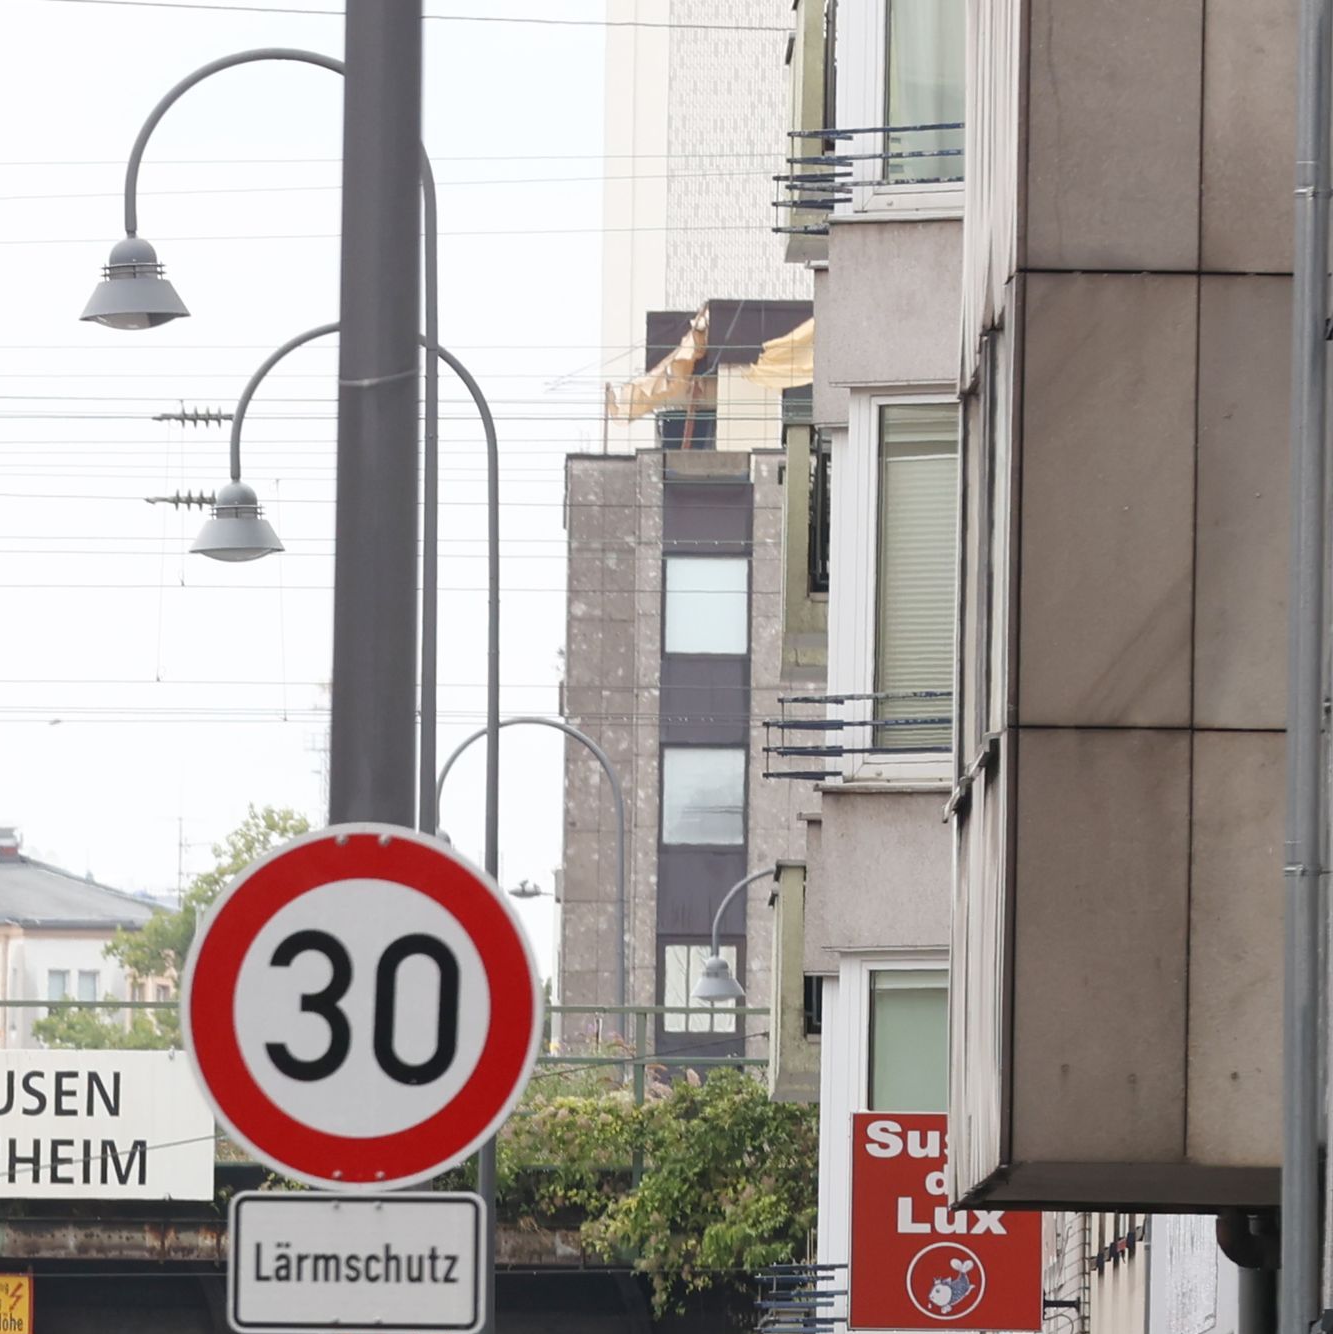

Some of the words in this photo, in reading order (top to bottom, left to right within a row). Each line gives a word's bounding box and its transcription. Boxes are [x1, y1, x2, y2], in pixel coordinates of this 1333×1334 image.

[264, 929, 460, 1085] 30
[896, 1197, 1007, 1235] Lux
[254, 1242, 460, 1284] Lärmschutz
